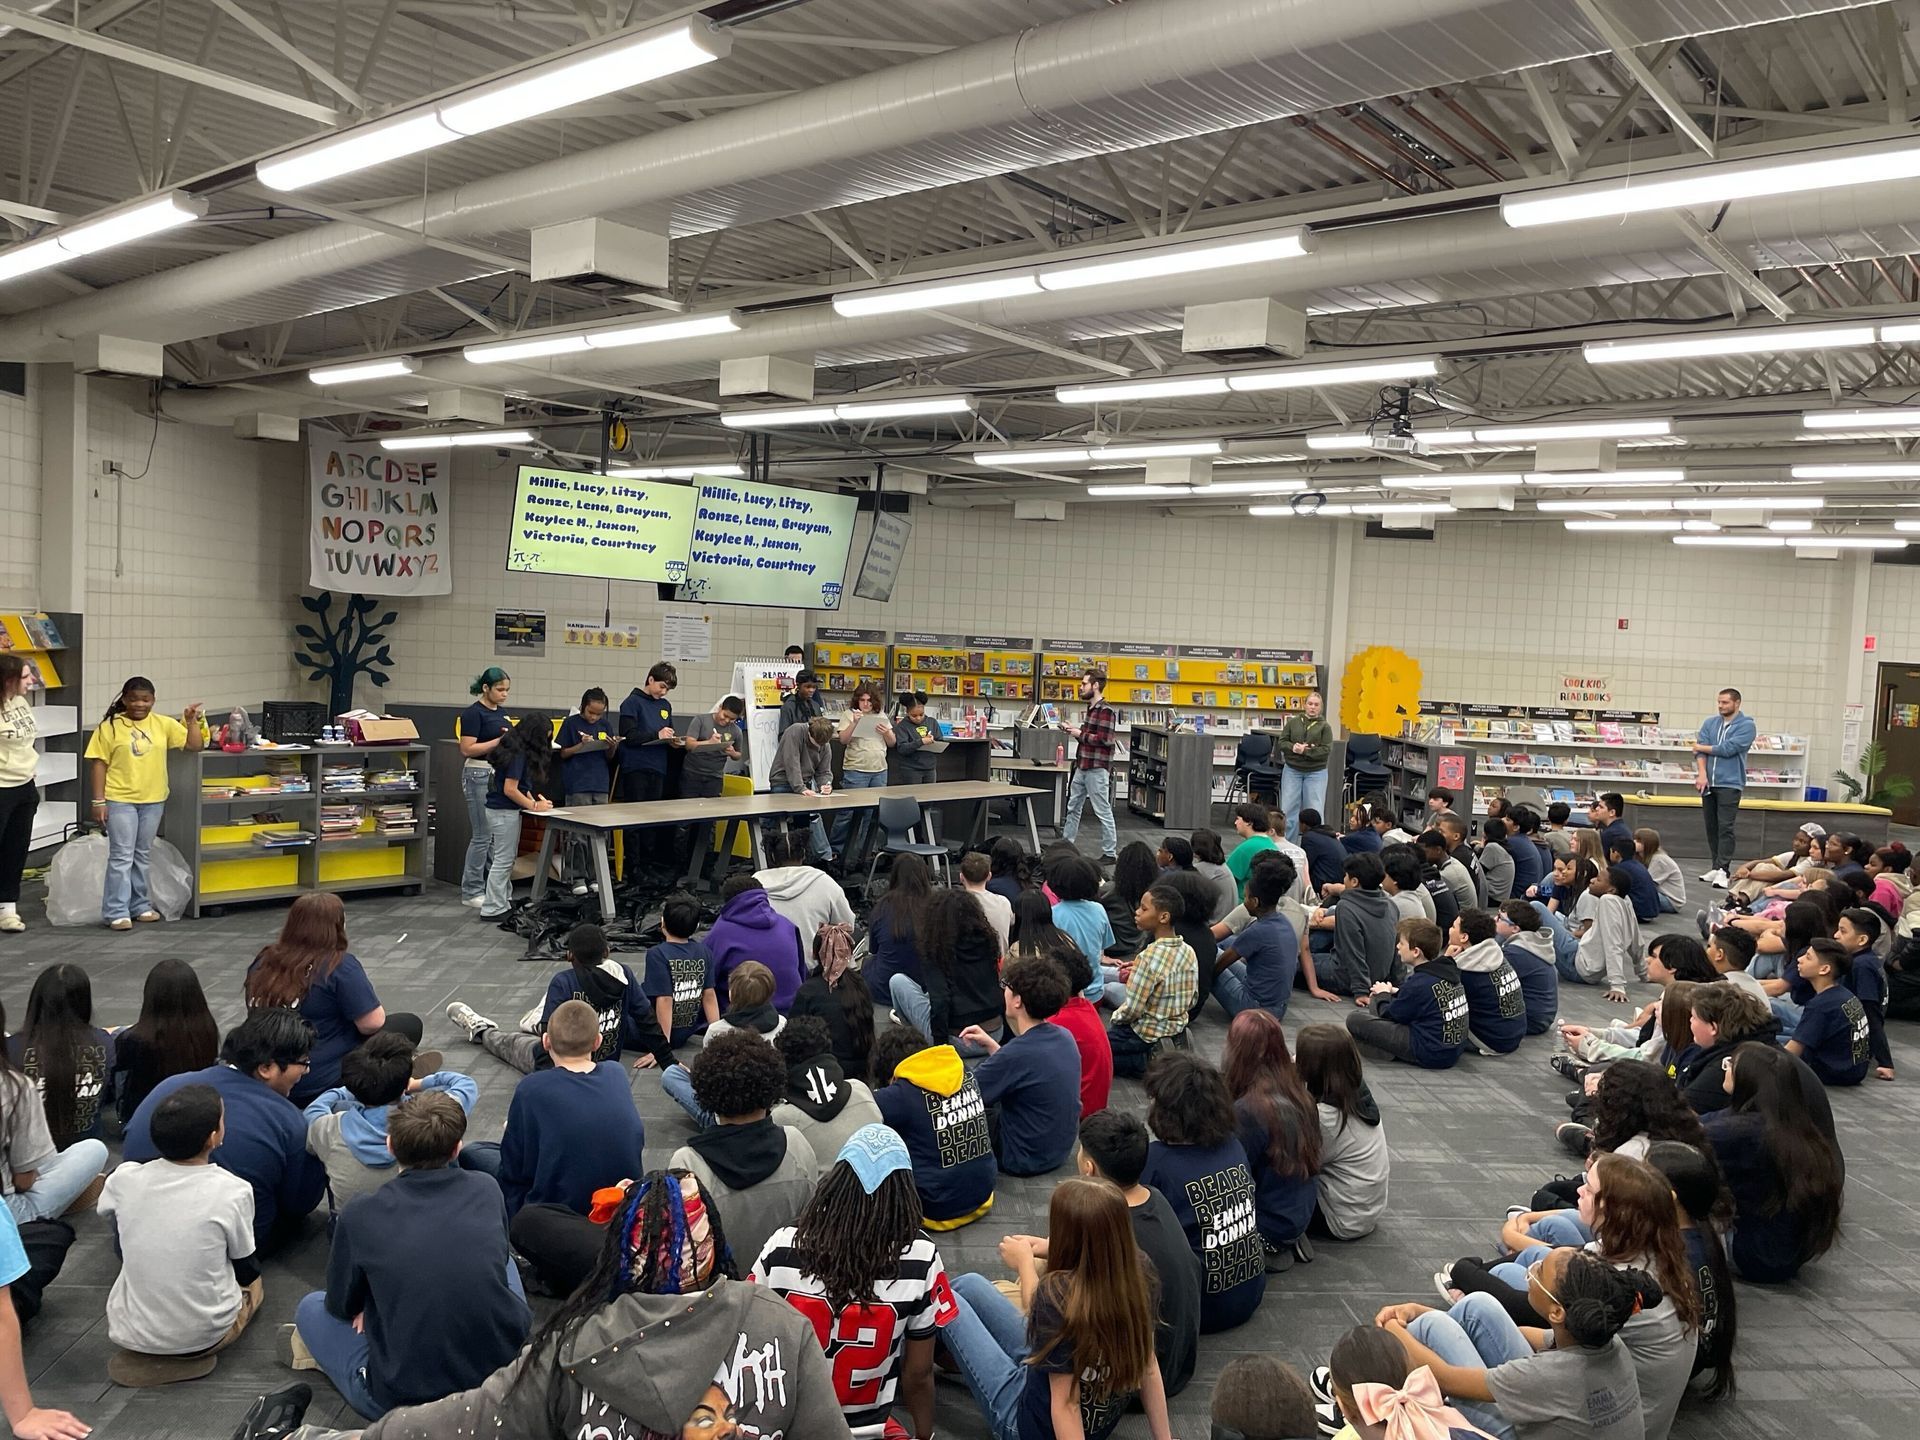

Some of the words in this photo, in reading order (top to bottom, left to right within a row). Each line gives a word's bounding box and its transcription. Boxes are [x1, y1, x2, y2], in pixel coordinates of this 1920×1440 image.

[527, 494, 574, 510] Ronze,
[573, 481, 609, 497] Lucy,
[611, 486, 649, 501] Litzy,
[744, 492, 777, 509] Lucy,
[779, 497, 813, 514] Litzy,
[525, 512, 574, 526] Kaylee
[698, 508, 742, 526] Ronze,
[322, 516, 436, 550] NOPQRS
[523, 530, 588, 547] Victoria,
[591, 536, 657, 554] Courtney
[695, 530, 742, 546] Kaylee
[692, 551, 753, 569] Victoria,
[756, 558, 817, 575] Courtney
[1564, 678, 1585, 688] COOL
[1586, 679, 1606, 689] KIDS
[1560, 692, 1581, 701] READ
[1583, 692, 1611, 702] BOOKS
[941, 1088, 978, 1113] EMMA
[936, 1117, 989, 1150] BEAR
[941, 1135, 992, 1168] BEAR
[1185, 1163, 1250, 1206] BEARS
[1213, 1198, 1252, 1230] EMMA
[1205, 1233, 1260, 1271] BEAR
